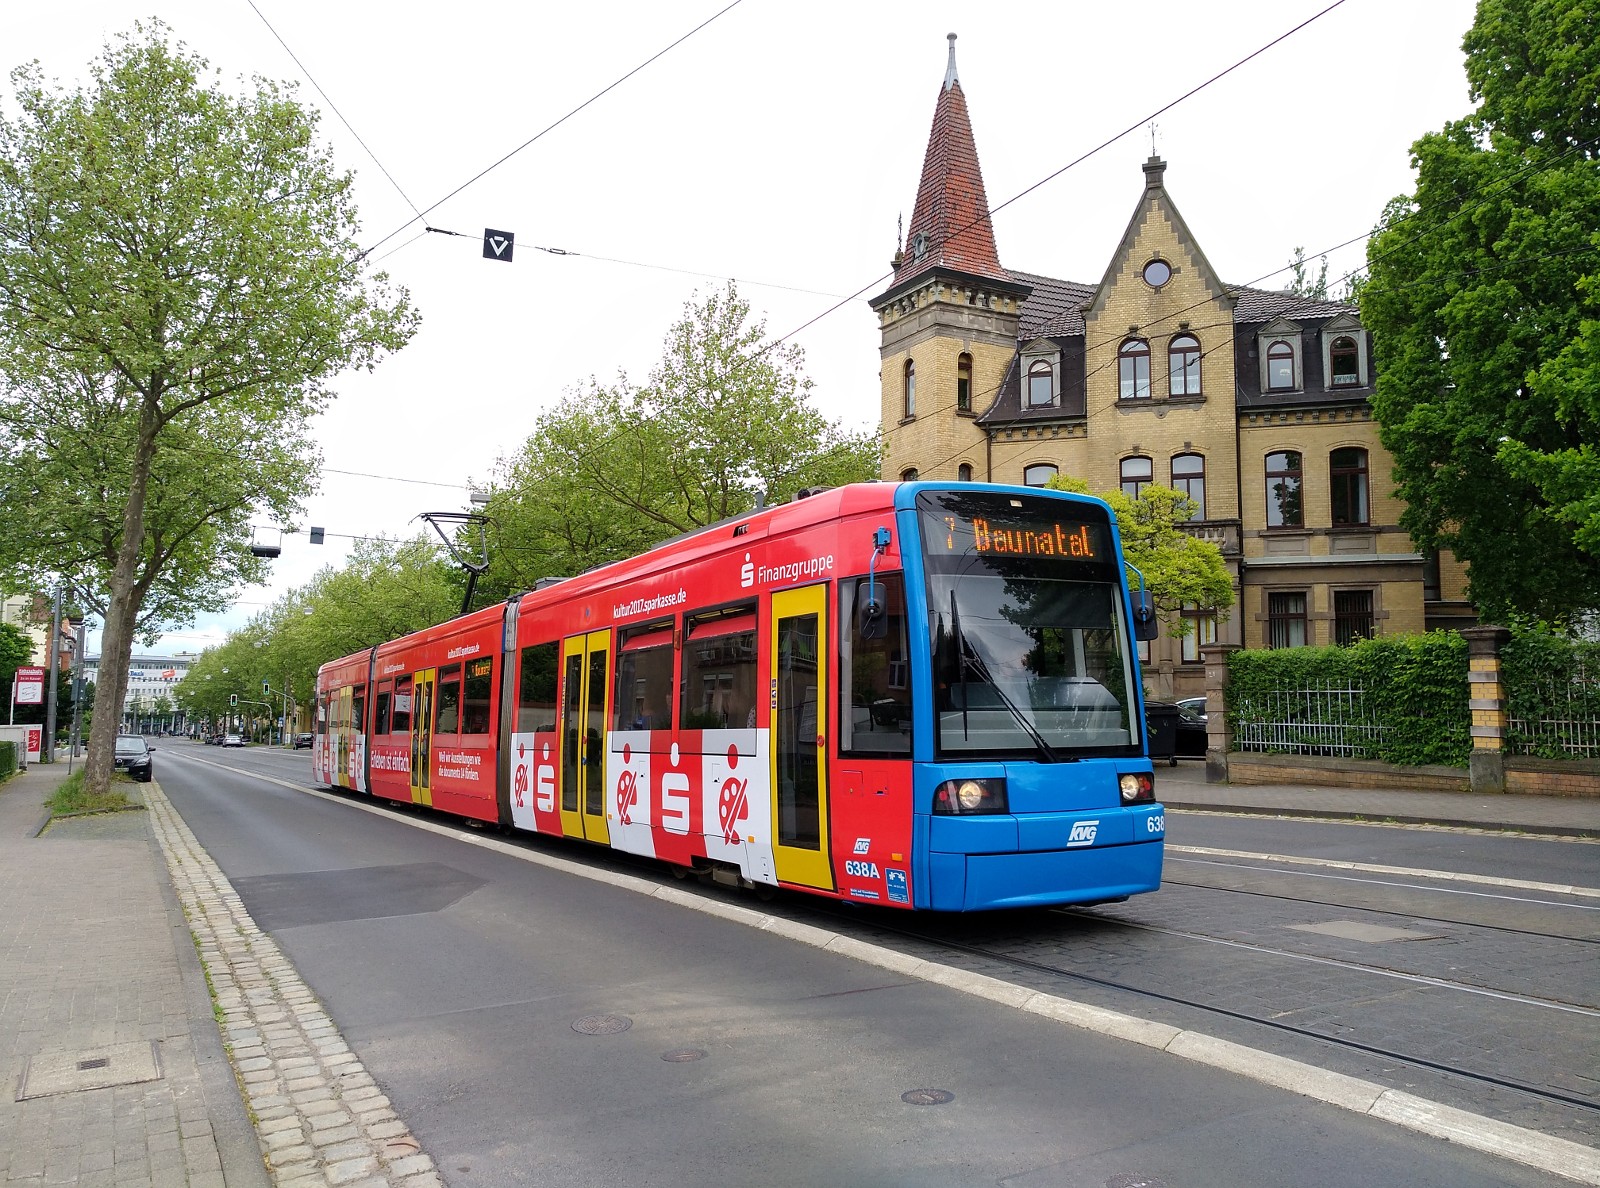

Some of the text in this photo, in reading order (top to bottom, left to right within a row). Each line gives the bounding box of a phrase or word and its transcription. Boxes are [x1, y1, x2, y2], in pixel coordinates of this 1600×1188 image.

[973, 517, 1094, 557] Baunatal
[758, 554, 834, 585] Finanzgruppe
[613, 587, 687, 619] kultur2017.sparkasse.de
[1067, 823, 1099, 844] KVG
[1147, 816, 1165, 833] 638
[845, 860, 881, 879] 638A
